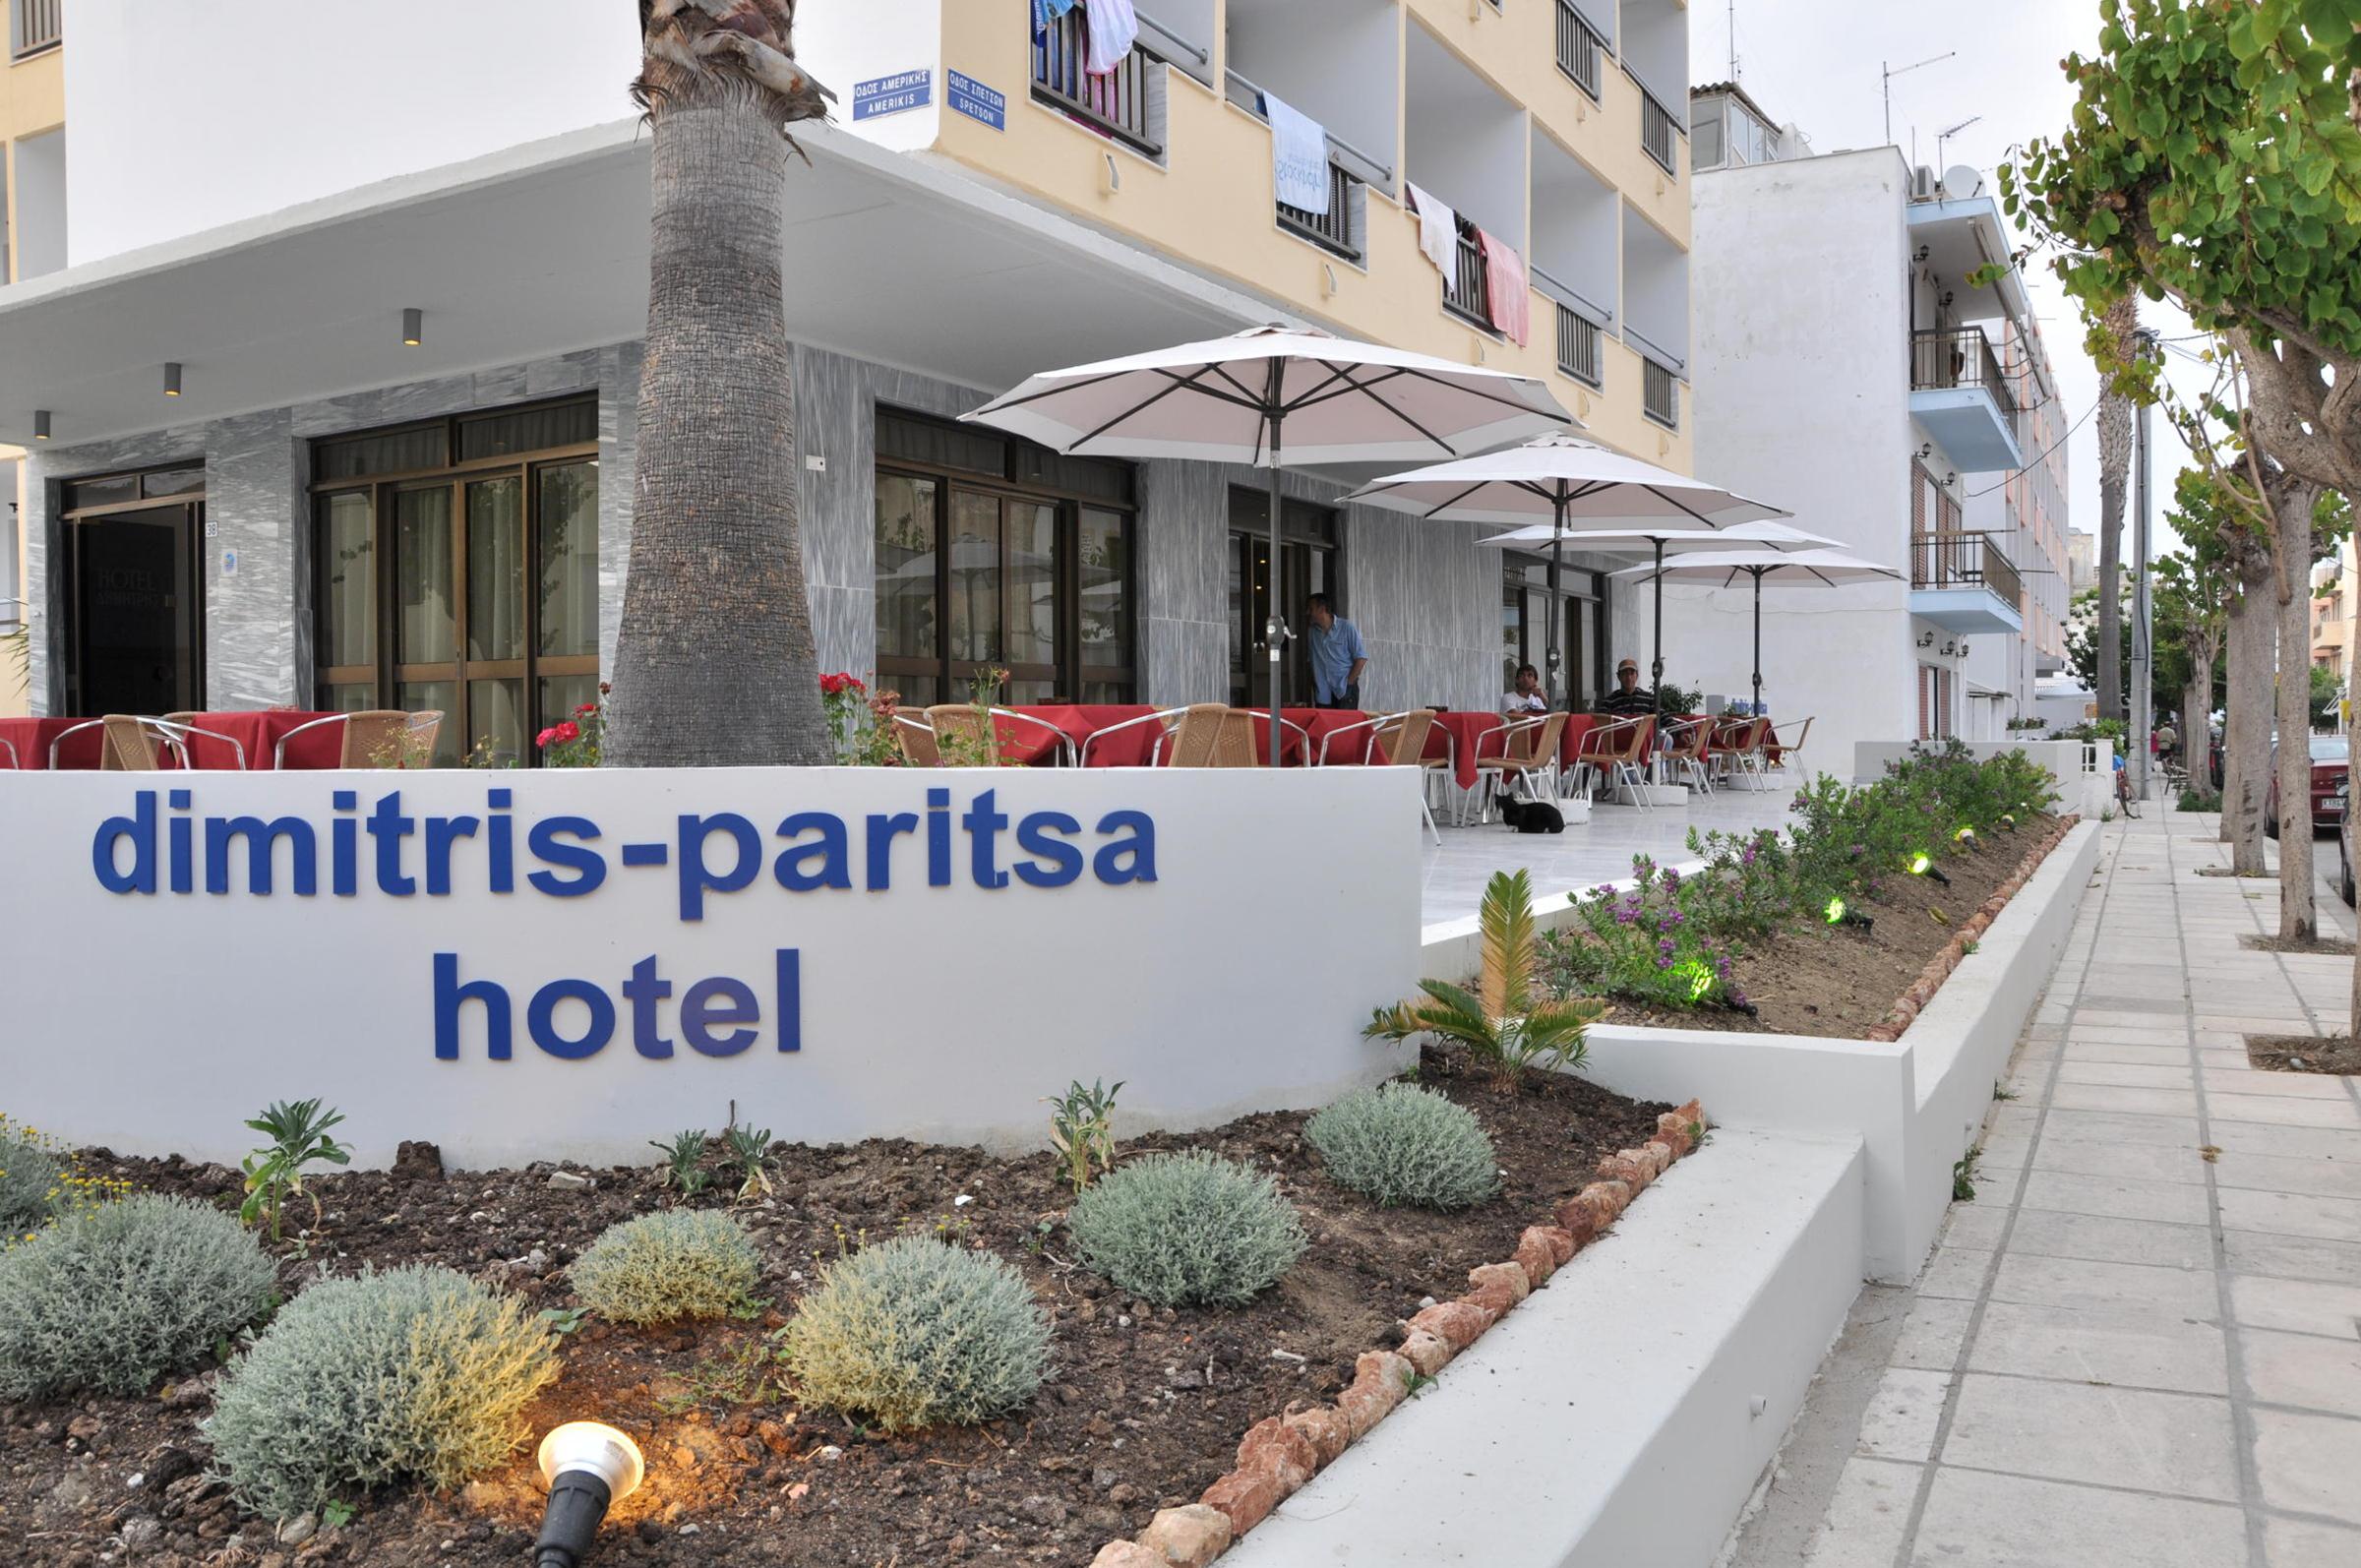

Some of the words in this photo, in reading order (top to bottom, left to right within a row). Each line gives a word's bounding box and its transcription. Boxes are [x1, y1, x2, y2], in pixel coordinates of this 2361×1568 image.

[856, 83, 878, 97] ΟΔΟΣ
[880, 71, 928, 90] ΑΜΕΡΙΚΗΣ
[949, 73, 969, 91] ΟΔΟΣ
[971, 83, 1003, 109] ΣΠΕΤΣΩΝ
[868, 93, 915, 114] AMERIKIS
[959, 97, 994, 124] SPETSON
[96, 567, 157, 590] HOTEL
[91, 786, 1158, 921] dimitris-paritsa
[432, 947, 801, 1059] hotel
